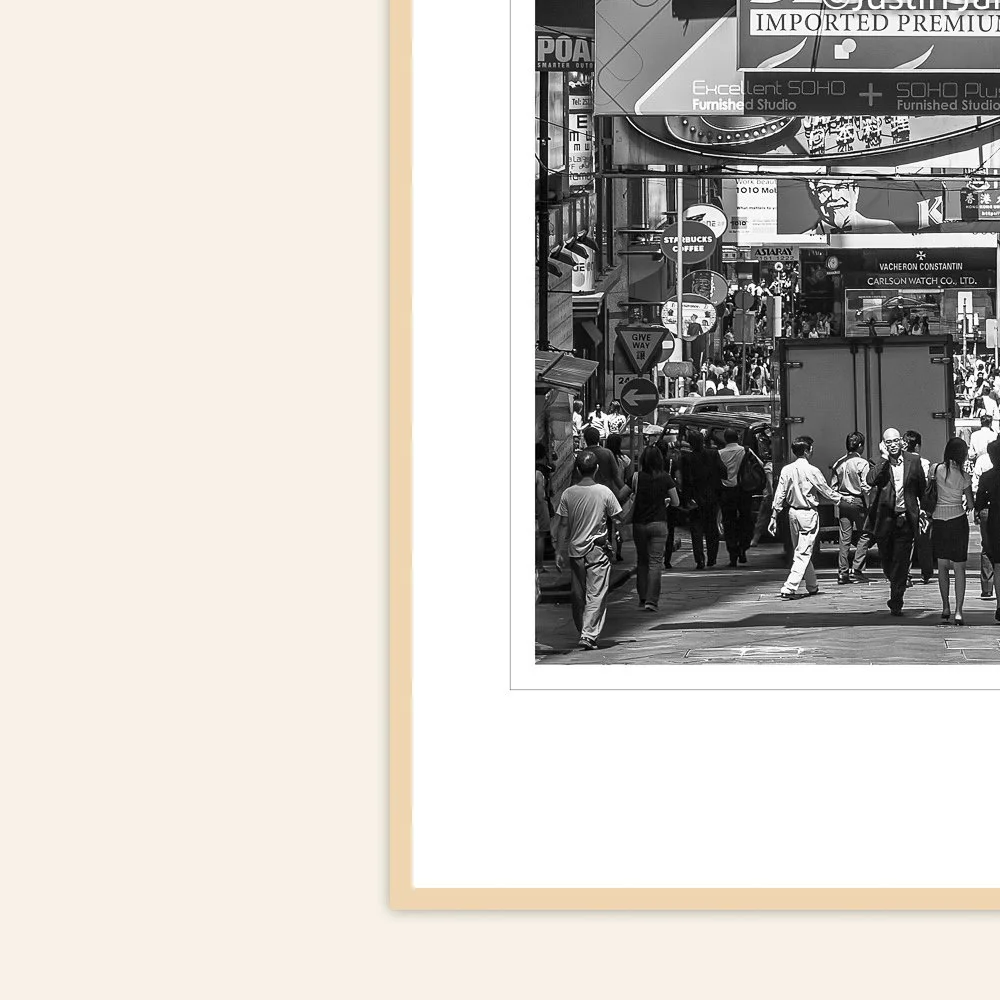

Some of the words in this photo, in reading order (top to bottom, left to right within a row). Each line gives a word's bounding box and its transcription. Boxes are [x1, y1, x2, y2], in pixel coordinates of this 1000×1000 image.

[756, 13, 889, 31] IMPORTED
[692, 80, 782, 96] Excellent
[788, 80, 847, 96] SOHO
[896, 82, 956, 98] SOHO
[692, 99, 753, 111] Furnished
[758, 99, 797, 111] Studio
[897, 100, 957, 112] Furnished
[961, 99, 1000, 111] Studio
[879, 263, 917, 271] VACHERON
[919, 262, 963, 271] CONSTANTIN
[867, 277, 907, 286] CARLSON
[908, 277, 938, 286] WATCH
[959, 277, 977, 285] LTD.
[631, 334, 651, 342] GIVE
